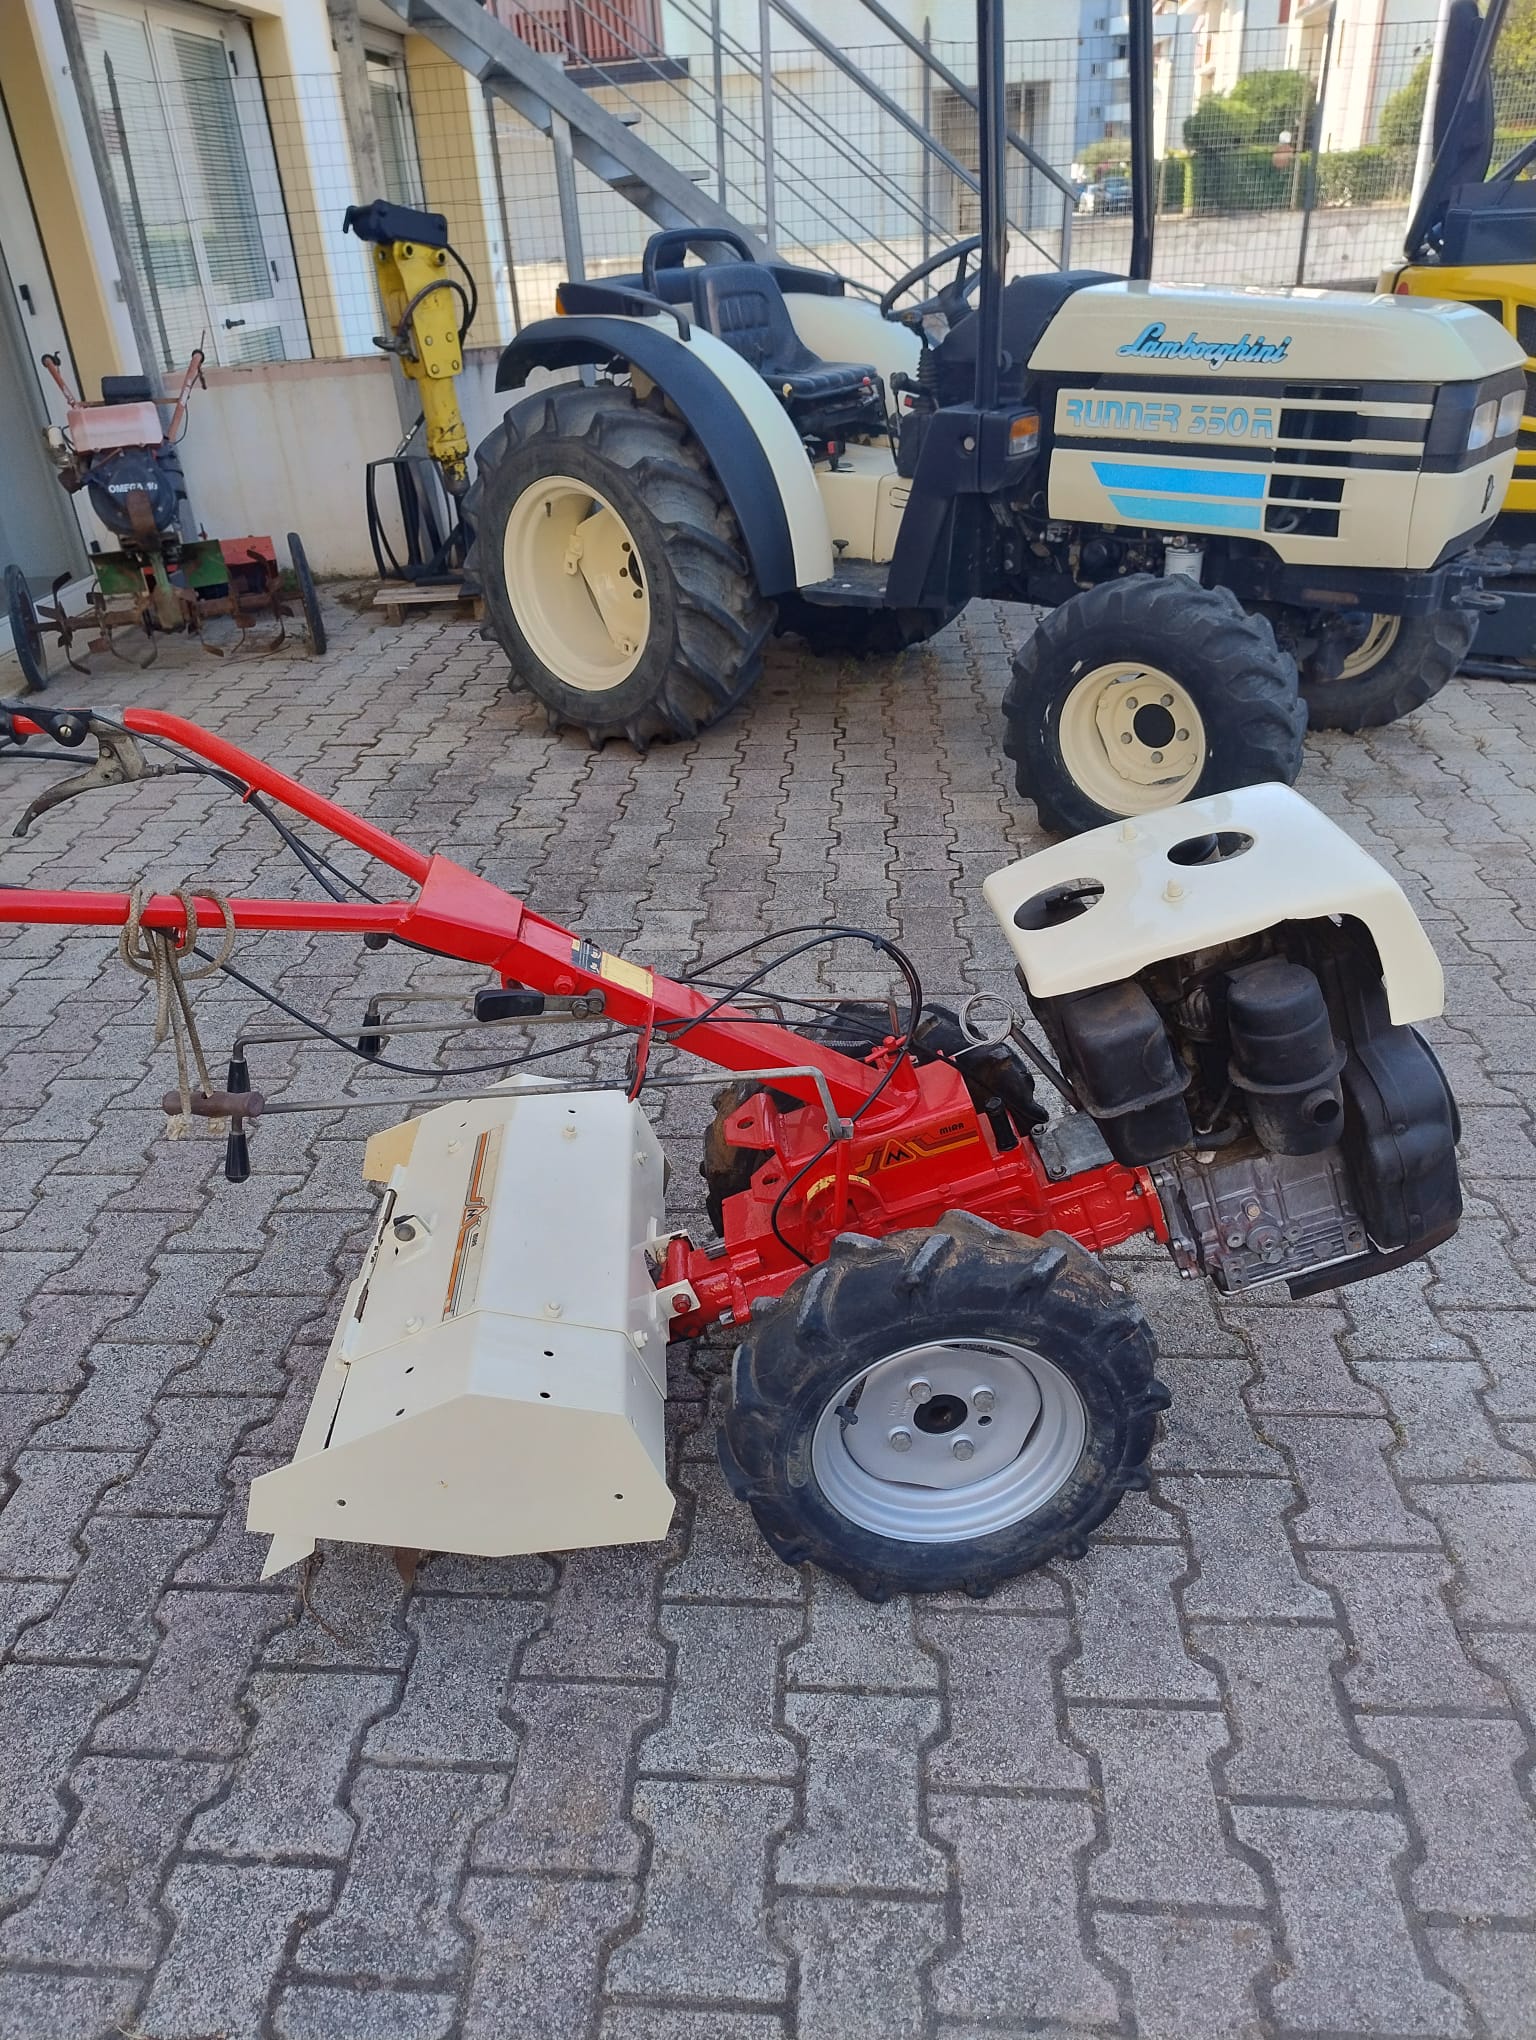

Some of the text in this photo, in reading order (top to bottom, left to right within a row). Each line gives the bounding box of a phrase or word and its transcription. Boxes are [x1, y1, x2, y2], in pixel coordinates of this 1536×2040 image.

[1116, 321, 1292, 371] Lamborghini
[1066, 399, 1181, 433] RUNNER
[939, 1122, 965, 1135] MIRA
